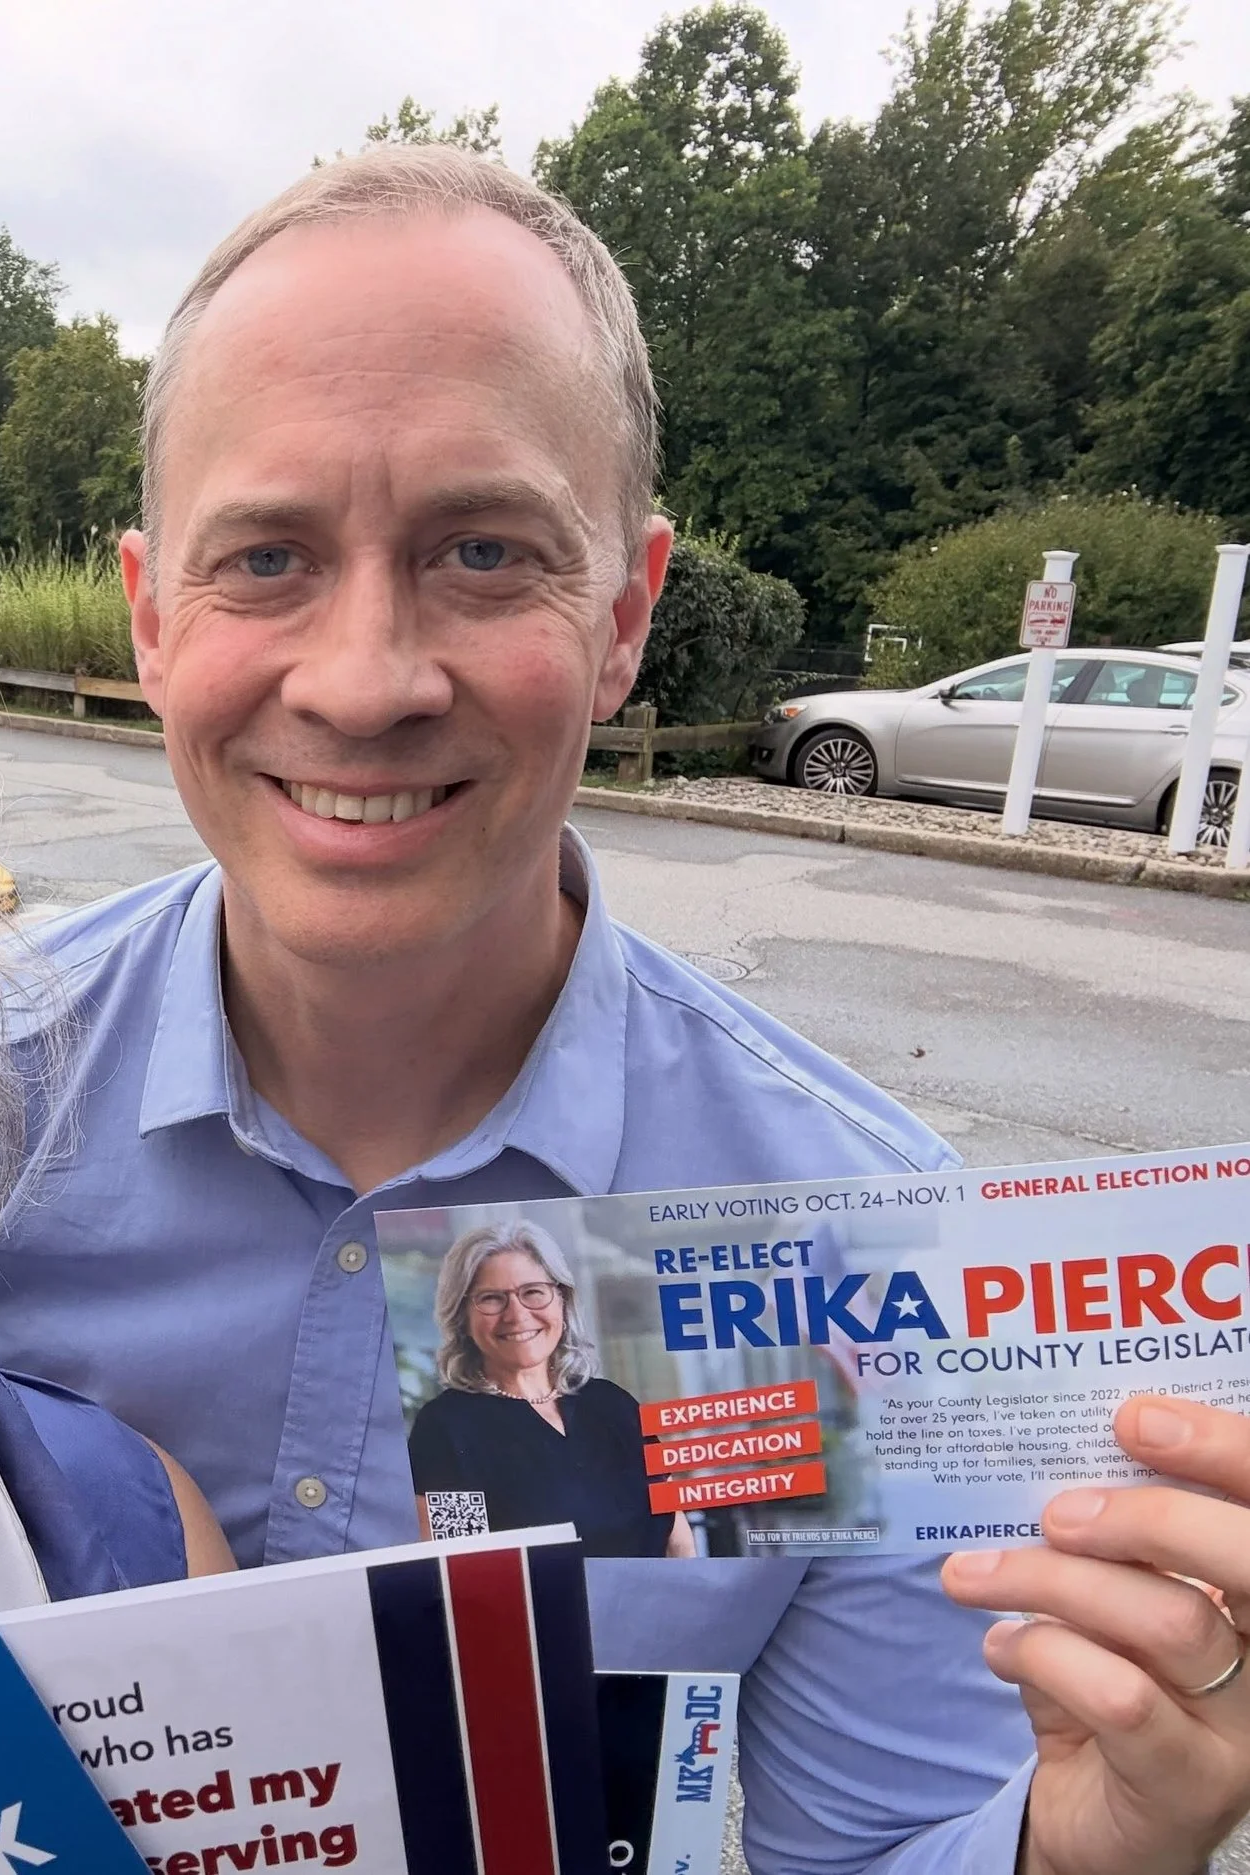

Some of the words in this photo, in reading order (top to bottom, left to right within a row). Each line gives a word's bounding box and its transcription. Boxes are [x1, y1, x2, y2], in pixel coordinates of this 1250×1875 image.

[1029, 600, 1070, 612] PARKING
[1043, 588, 1057, 599] NO
[981, 1175, 1090, 1200] GENERAL
[1096, 1163, 1208, 1191] ELECTION
[650, 1202, 710, 1222] EARLY
[715, 1196, 798, 1218] VOTING
[805, 1192, 855, 1212] OCT.
[956, 1185, 965, 1202] 1
[654, 1240, 813, 1275] RE-ELECT
[658, 1271, 950, 1351] ERIKA
[963, 1244, 1250, 1338] PIERC
[858, 1351, 922, 1376] FOR
[937, 1342, 1084, 1374] COUNTY
[1100, 1328, 1250, 1366] LEGISLAT
[660, 1391, 796, 1426] EXPERIENCE
[879, 1414, 896, 1425] for
[900, 1416, 927, 1424] over
[932, 1413, 947, 1423] 25
[950, 1413, 989, 1425] years,
[1020, 1409, 1056, 1420] taken
[1060, 1410, 1076, 1419] on
[1081, 1407, 1113, 1419] utility
[1210, 1394, 1234, 1407] and
[907, 1400, 933, 1410] your
[938, 1396, 982, 1409] County
[986, 1394, 1049, 1408] Legislator
[1053, 1392, 1085, 1403] since
[1158, 1387, 1167, 1396] a
[1172, 1381, 1212, 1395] District
[1217, 1379, 1224, 1390] 2
[866, 1430, 893, 1441] hold
[898, 1429, 917, 1440] the
[921, 1428, 944, 1439] line
[948, 1429, 964, 1438] on
[968, 1427, 1006, 1438] taxes.
[1037, 1423, 1098, 1437] protected
[662, 1431, 802, 1466] DEDICATION
[875, 1445, 921, 1457] funding
[926, 1443, 941, 1455] for
[946, 1441, 1014, 1454] affordable
[884, 1459, 938, 1472] standing
[942, 1461, 959, 1470] up
[963, 1457, 978, 1468] for
[984, 1456, 1036, 1468] families,
[1040, 1454, 1089, 1466] seniors,
[678, 1473, 794, 1504] INTEGRITY
[934, 1473, 961, 1484] With
[965, 1474, 992, 1485] your
[997, 1472, 1026, 1483] vote,
[1049, 1468, 1103, 1481] continue
[1107, 1468, 1128, 1478] this
[750, 1533, 766, 1542] PAID
[767, 1532, 781, 1541] FOR
[782, 1532, 791, 1541] BY
[792, 1532, 821, 1541] FRIENDS
[821, 1532, 831, 1541] OF
[832, 1531, 851, 1541] ERIKA
[853, 1531, 877, 1540] PIERCE
[80, 1735, 154, 1769] who
[165, 1725, 234, 1756] has
[249, 1762, 342, 1808] my
